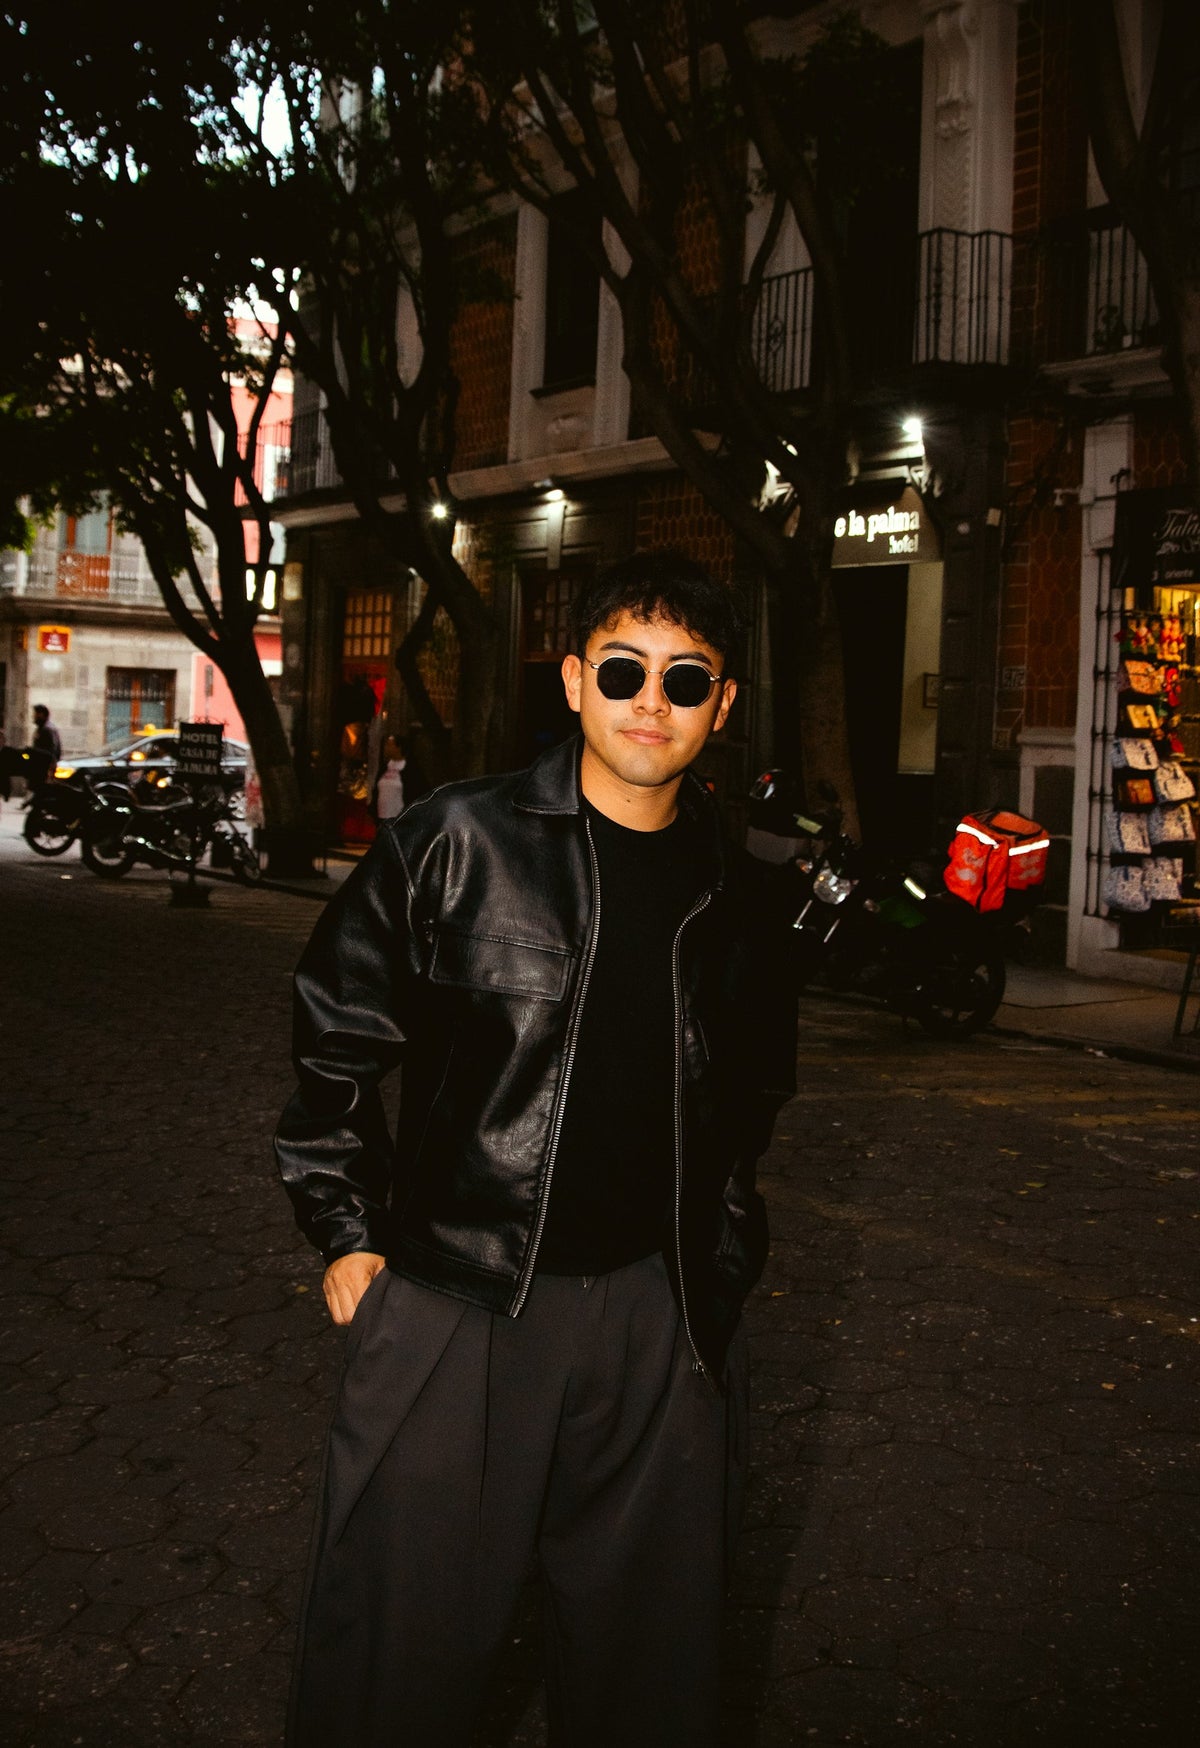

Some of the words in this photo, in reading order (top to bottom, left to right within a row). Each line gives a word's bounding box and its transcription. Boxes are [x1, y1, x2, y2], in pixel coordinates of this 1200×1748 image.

[848, 509, 866, 537] la
[867, 505, 920, 543] palma
[888, 533, 919, 554] hotel
[182, 732, 218, 744] HOTEL
